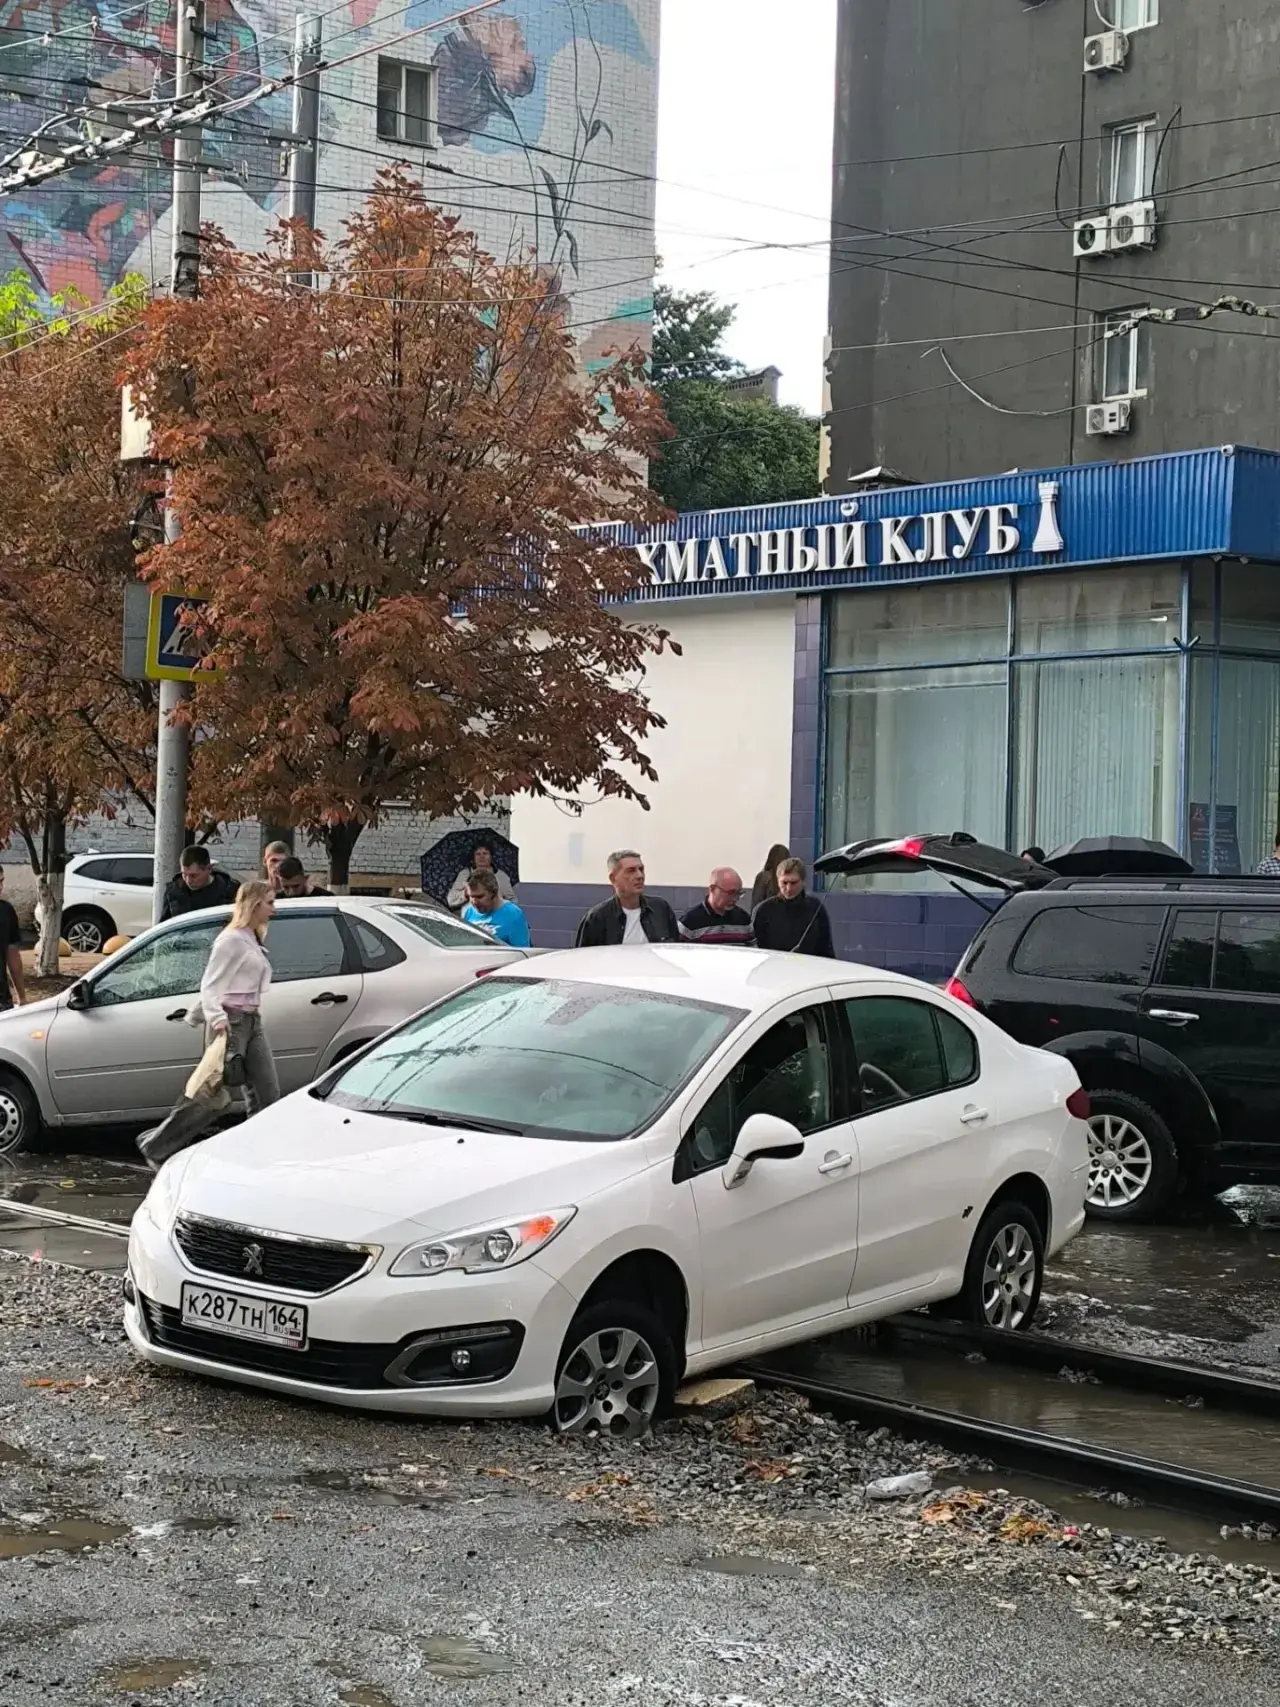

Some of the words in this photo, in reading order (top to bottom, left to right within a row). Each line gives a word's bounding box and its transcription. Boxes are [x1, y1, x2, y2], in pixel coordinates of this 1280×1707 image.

[545, 502, 869, 591] ХМАТНЫЙ
[879, 504, 1020, 566] КЛУБ
[188, 1292, 263, 1329] К287ТН
[268, 1305, 298, 1328] 164
[273, 1325, 289, 1335] RUS
